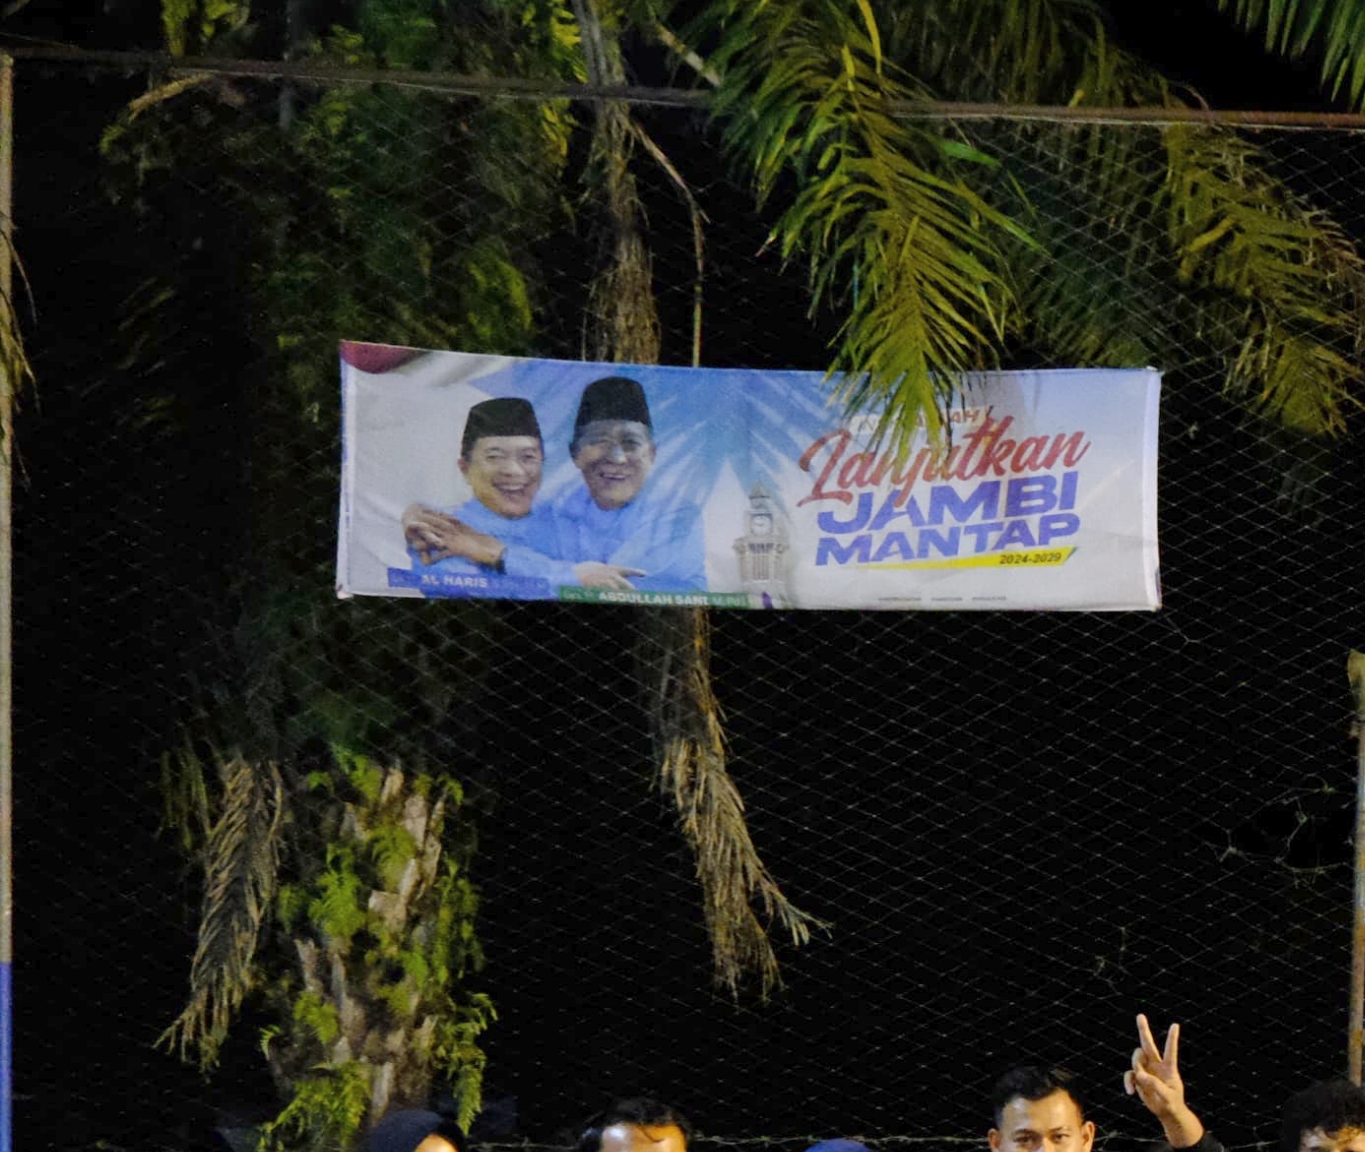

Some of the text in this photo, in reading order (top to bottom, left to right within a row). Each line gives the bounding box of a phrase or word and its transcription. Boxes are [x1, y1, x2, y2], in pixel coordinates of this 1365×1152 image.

[817, 471, 1080, 536] JAMBI
[815, 512, 1081, 567] MANTAP
[1000, 551, 1062, 566] 2024-2029
[444, 576, 489, 589] HARIS
